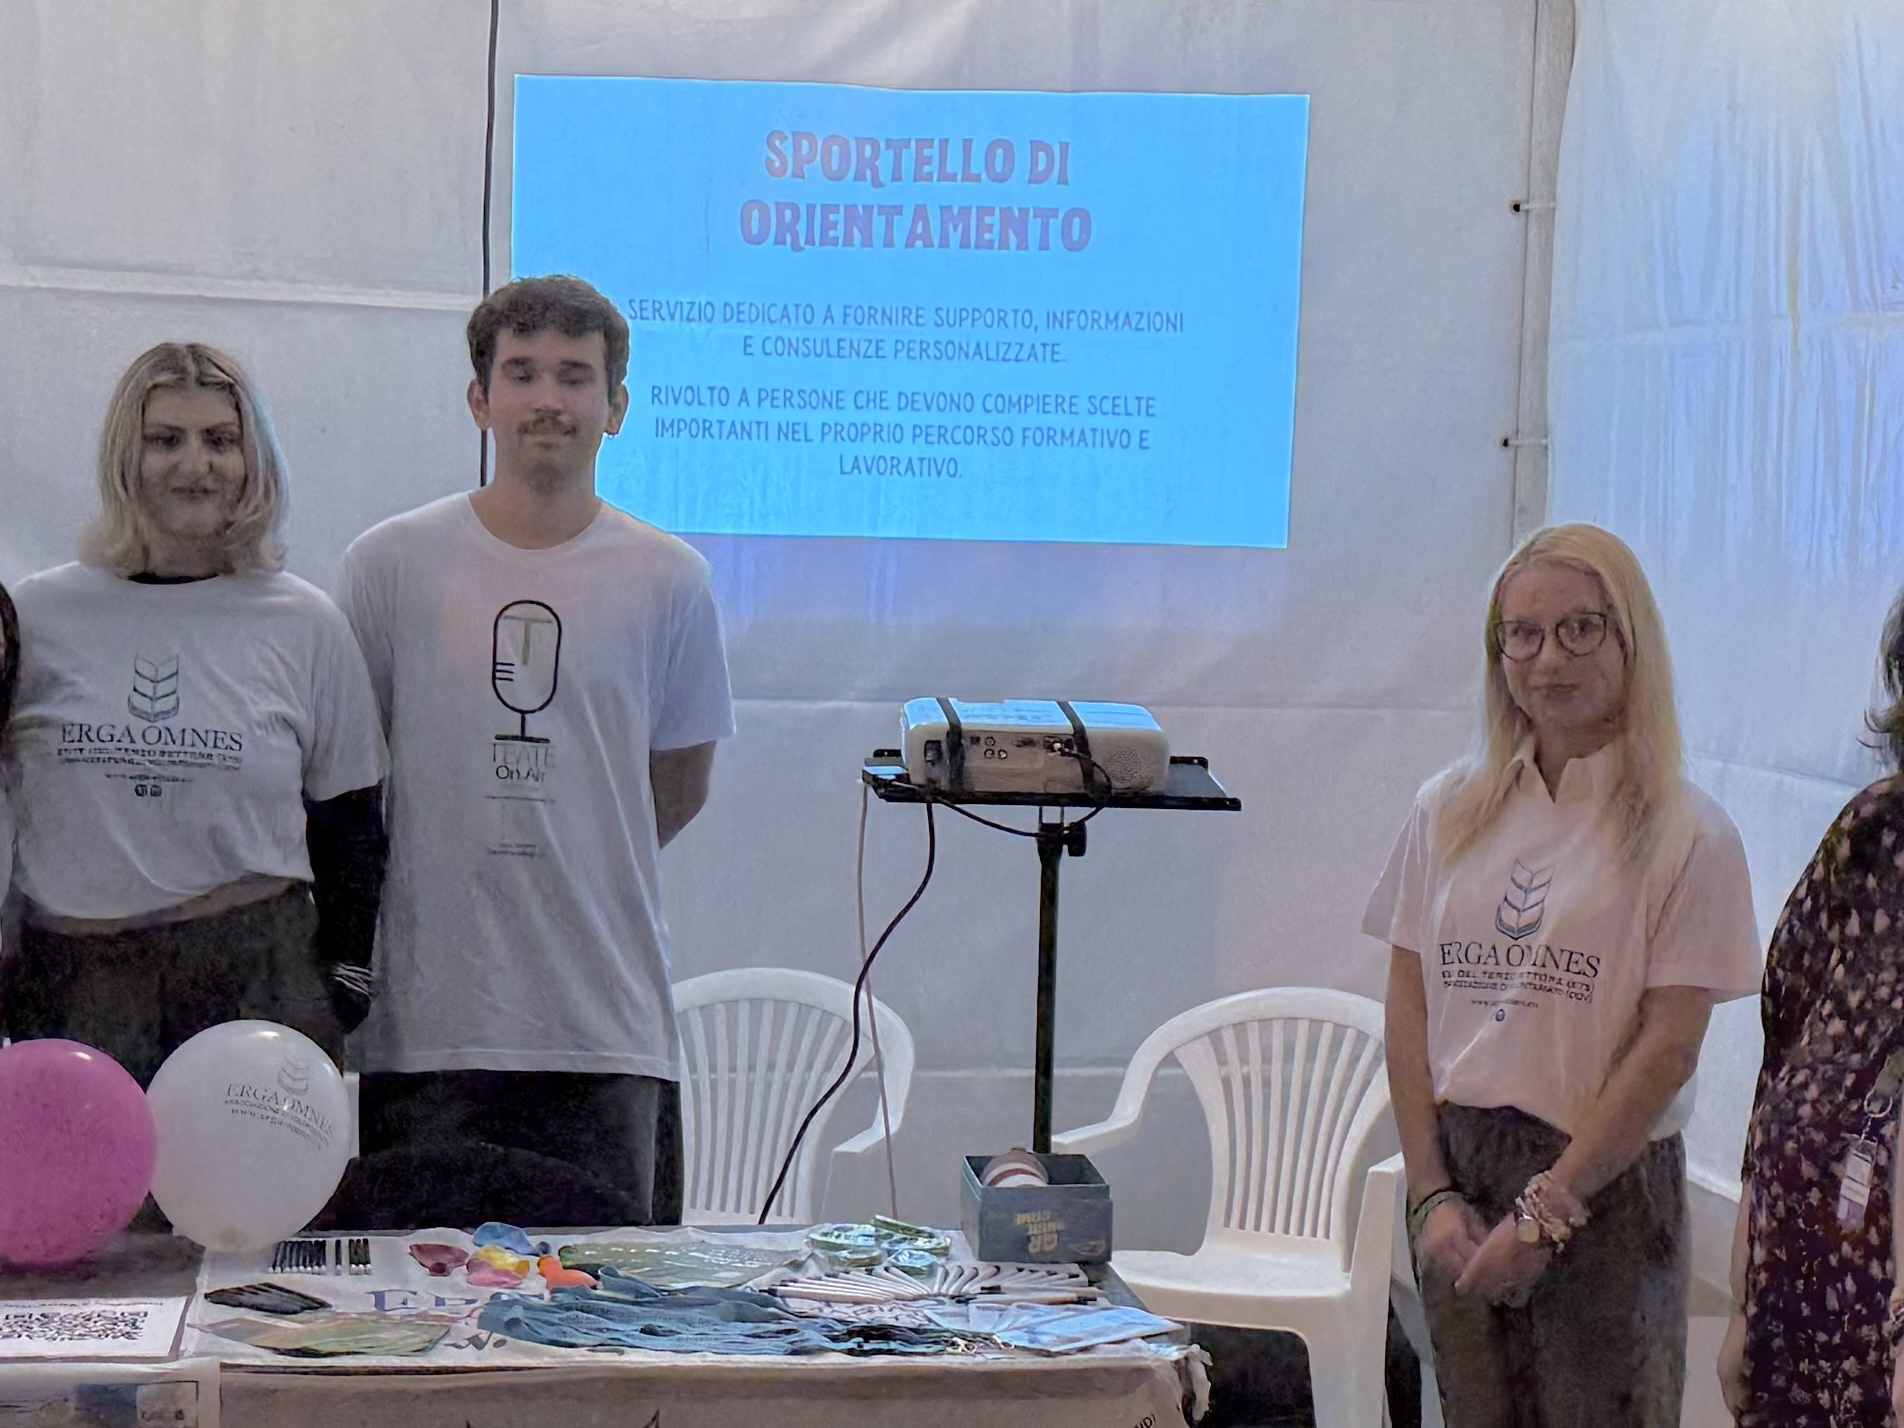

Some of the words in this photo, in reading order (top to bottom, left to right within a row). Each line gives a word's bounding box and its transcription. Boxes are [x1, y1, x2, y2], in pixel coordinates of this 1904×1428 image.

[766, 131, 1016, 188] SPORTELLO
[1031, 140, 1069, 185] DI
[740, 199, 1092, 252] ORIENTAMENTO
[629, 299, 716, 324] SERVIZIO
[722, 301, 815, 326] DEDICATO
[843, 303, 926, 329] FORNIRE
[935, 305, 1039, 331] SUPPORTO,
[1046, 308, 1184, 333] INFORMAZIONI
[762, 335, 887, 361] CONSULENZE
[895, 338, 1066, 363] PERSONALIZZATE.
[651, 387, 729, 409] RIVOLTO
[758, 388, 845, 411] PERSONE
[853, 389, 889, 411] CHE
[897, 390, 975, 414] DEVONO
[983, 392, 1080, 415] COMPIERE
[1089, 395, 1156, 417] SCELTE
[655, 418, 769, 443] IMPORTANTI
[778, 421, 812, 443] NEL
[820, 421, 903, 444] PROPRIO
[913, 423, 1013, 447] PERCORSO
[1022, 424, 1130, 449] FORMATIVO
[840, 453, 963, 478] LAVORATIVO.
[62, 723, 136, 743] ERGA
[142, 725, 243, 751] OMNES
